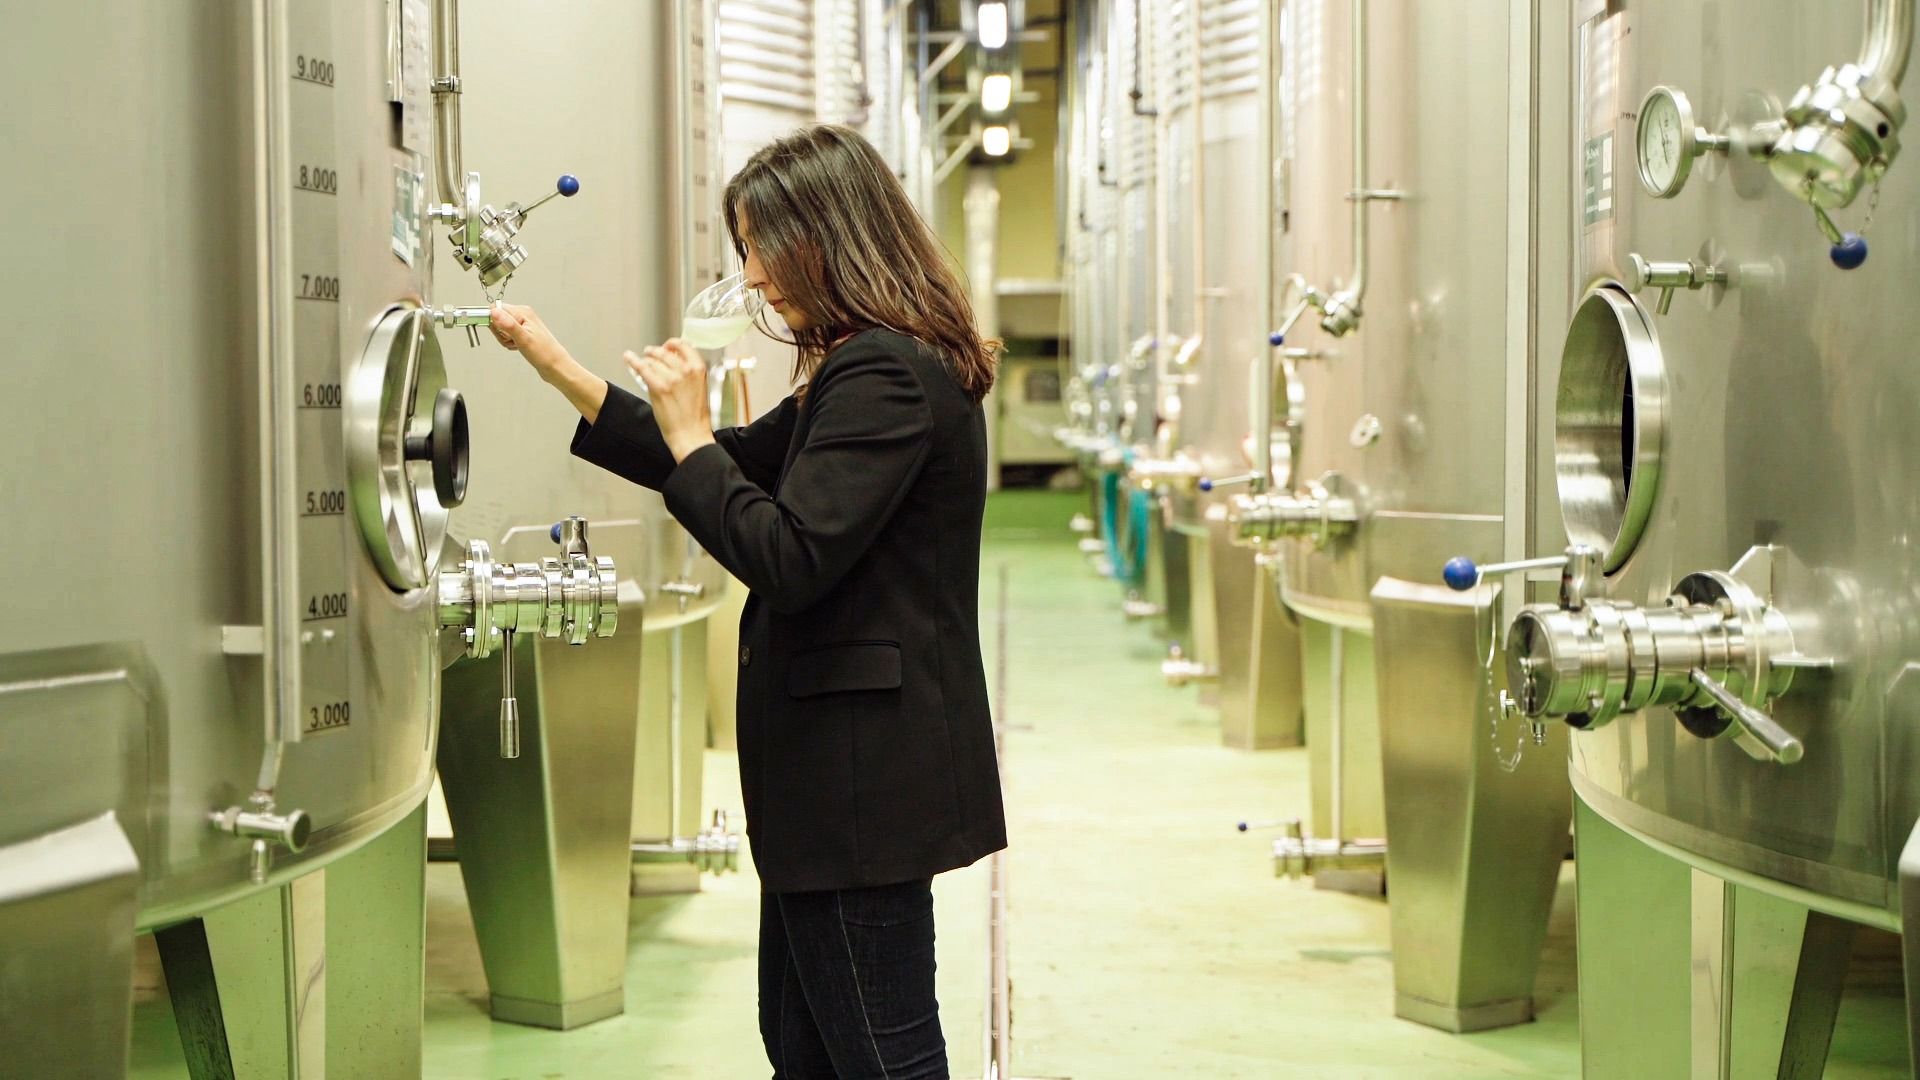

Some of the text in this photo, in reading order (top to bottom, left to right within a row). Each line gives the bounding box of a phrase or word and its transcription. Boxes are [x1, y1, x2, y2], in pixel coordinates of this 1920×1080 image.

[297, 54, 334, 84] 9.000
[300, 164, 336, 192] 8.000
[301, 274, 339, 299] 7.000
[304, 383, 341, 405] 6.000
[307, 490, 344, 512] 5.000
[309, 593, 347, 616] 4.000
[310, 701, 350, 728] 3.000
